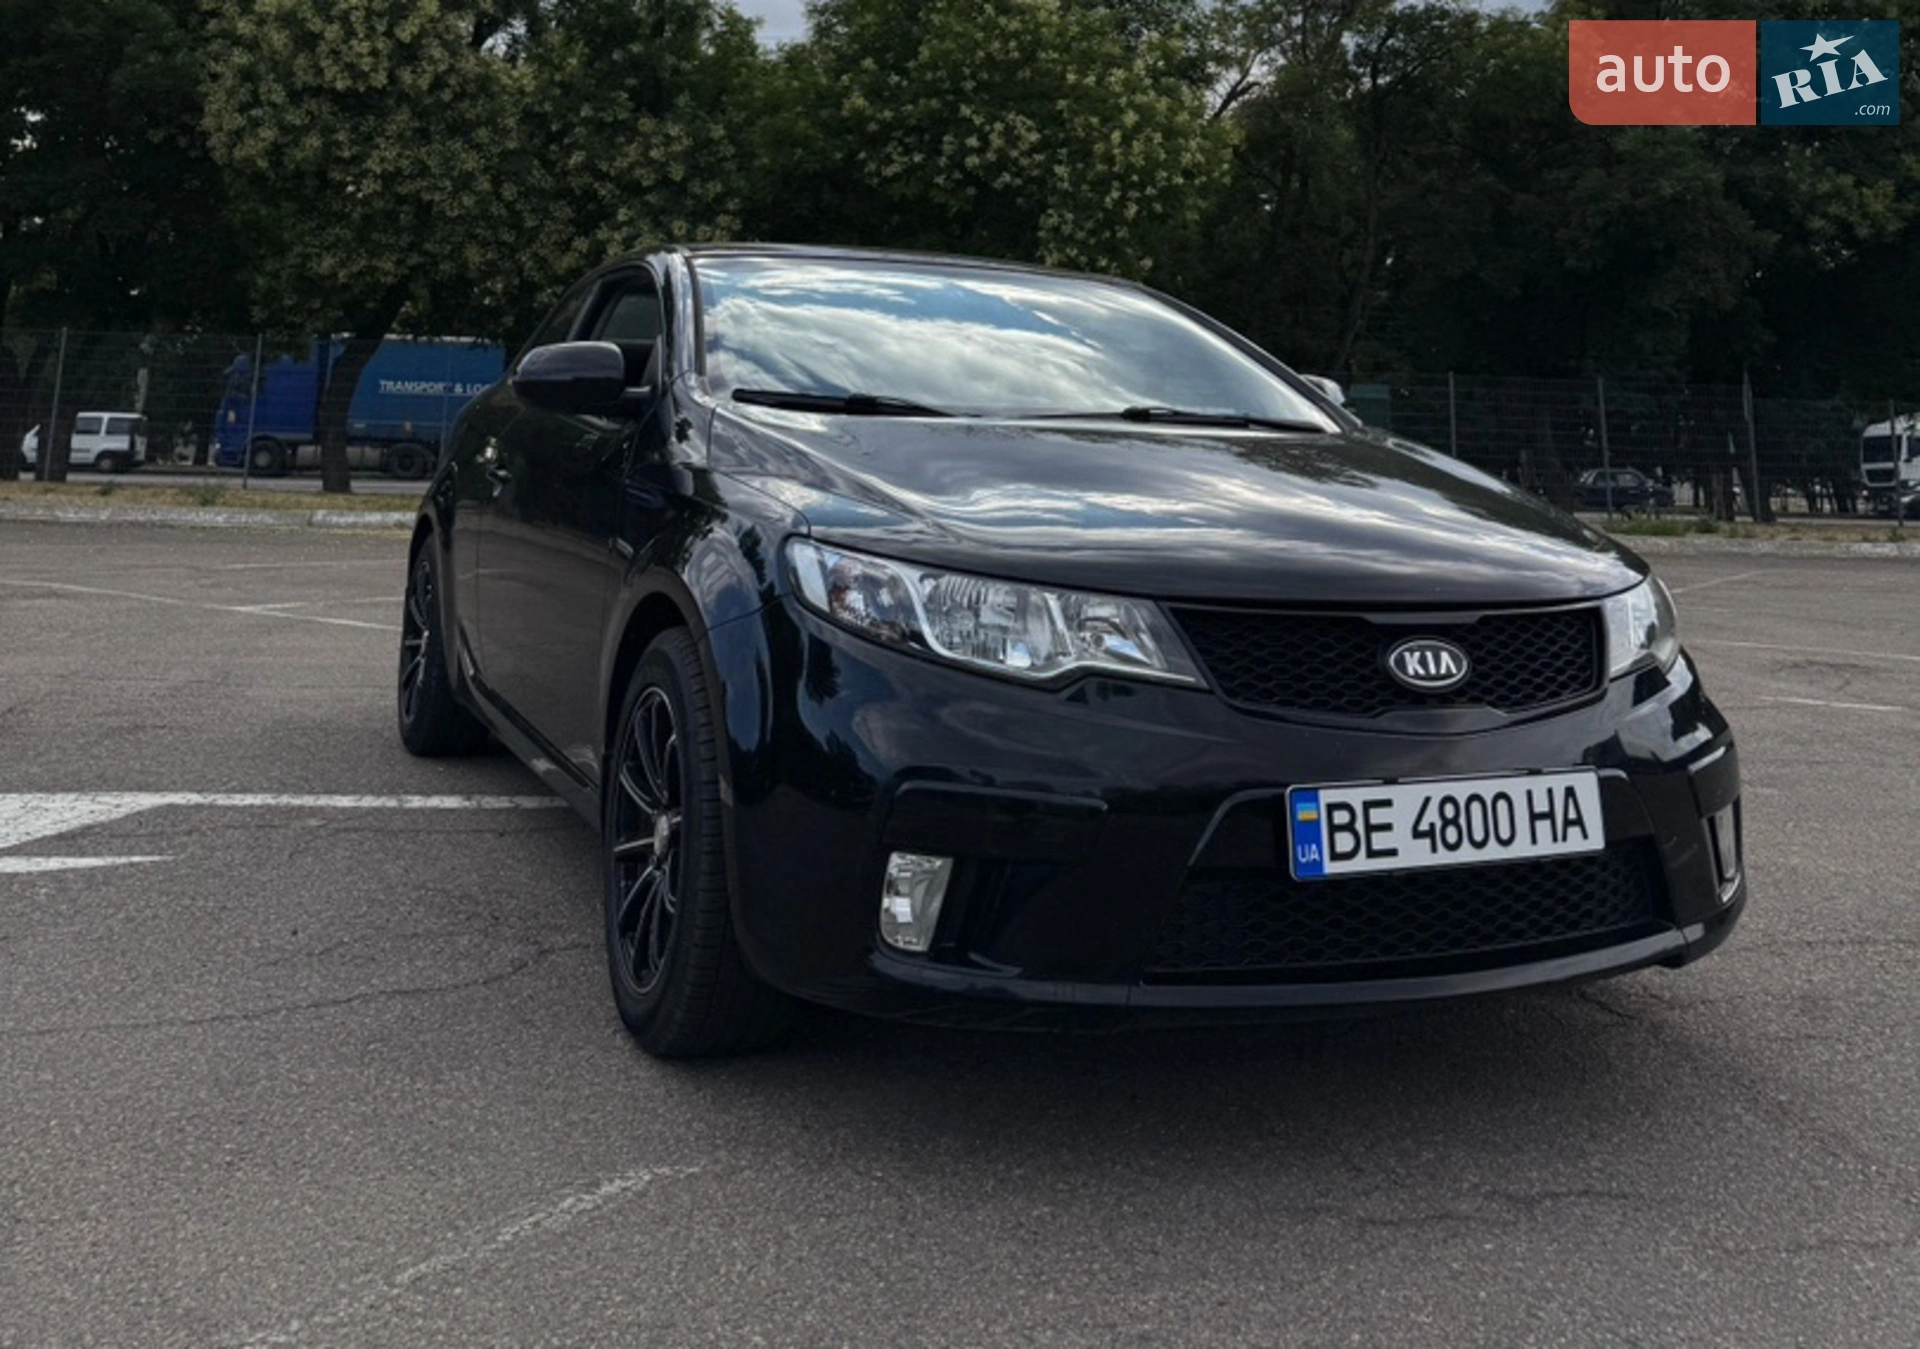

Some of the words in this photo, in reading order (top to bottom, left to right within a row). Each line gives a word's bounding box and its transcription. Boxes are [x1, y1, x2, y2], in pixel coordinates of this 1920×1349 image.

[454, 382, 464, 394] &
[1402, 651, 1457, 676] KIA
[1326, 798, 1399, 863] BE
[1411, 790, 1517, 854] 4800
[1526, 785, 1589, 846] HA
[1298, 844, 1321, 863] UA
